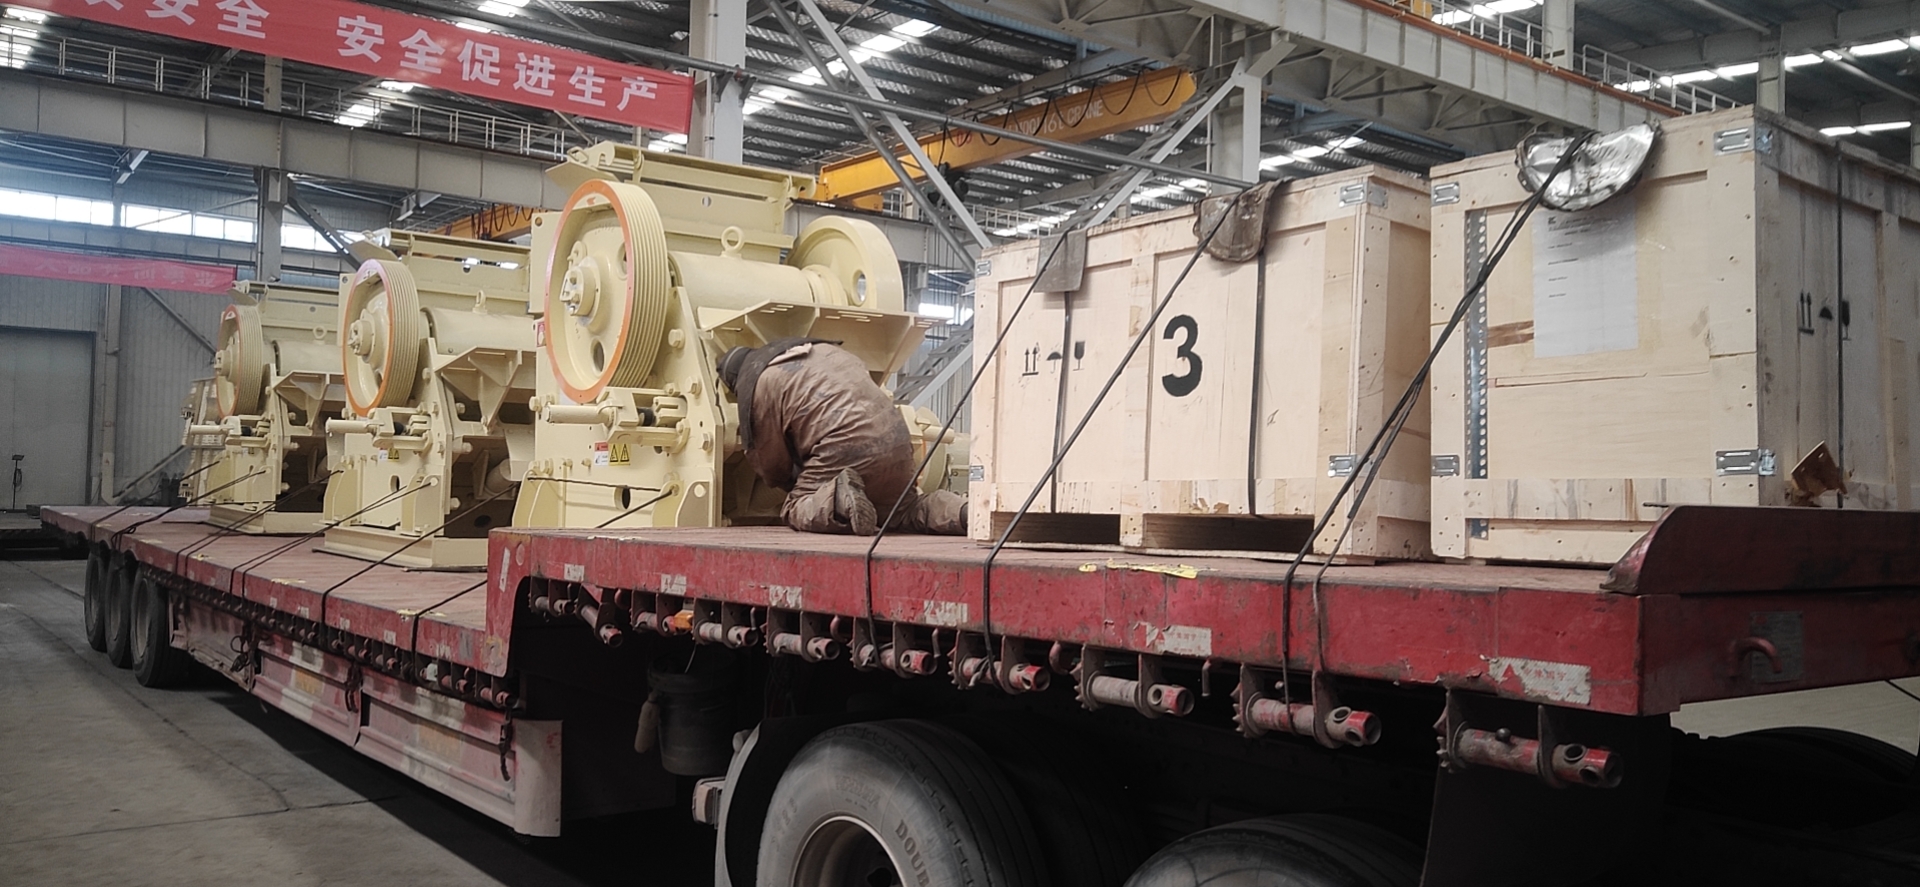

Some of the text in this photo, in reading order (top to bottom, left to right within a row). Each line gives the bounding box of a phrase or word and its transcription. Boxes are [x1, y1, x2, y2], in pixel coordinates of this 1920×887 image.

[85, 0, 659, 112] 安全 安全促进生产
[1067, 99, 1104, 125] CRANE
[1162, 314, 1203, 397] 3
